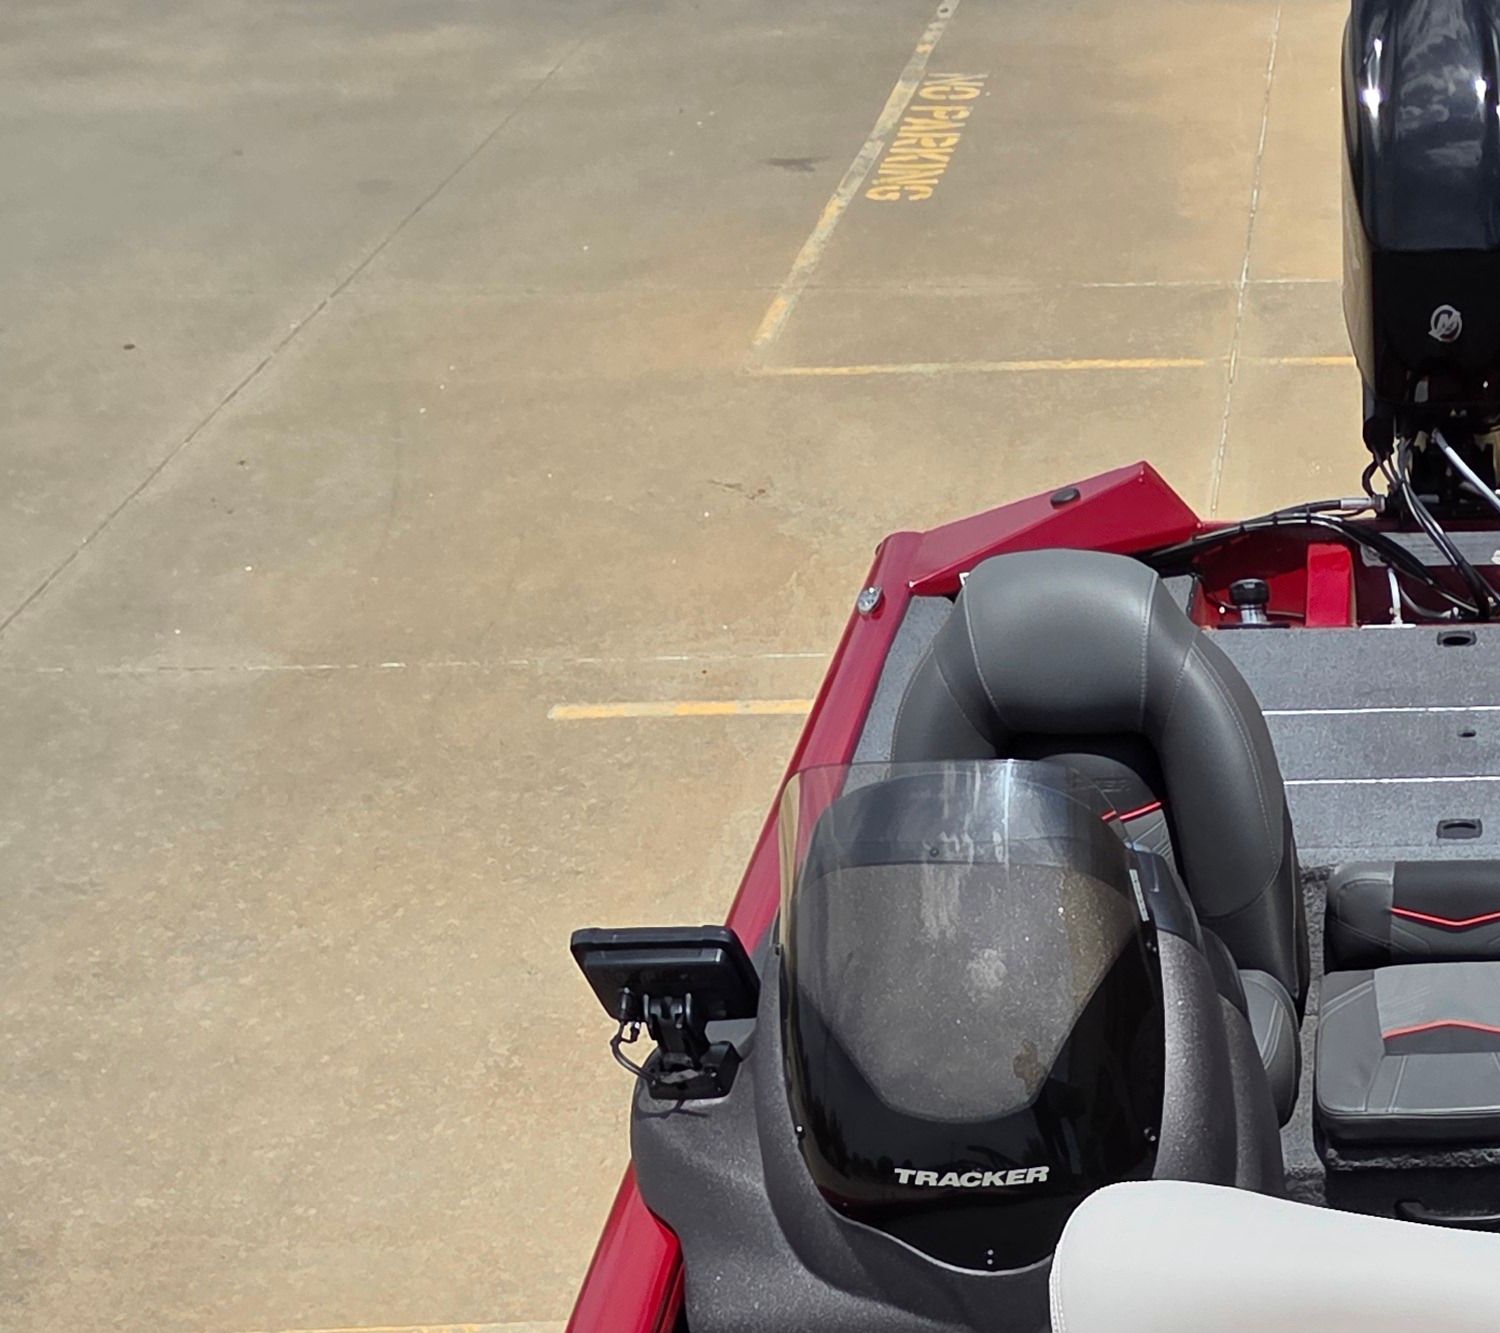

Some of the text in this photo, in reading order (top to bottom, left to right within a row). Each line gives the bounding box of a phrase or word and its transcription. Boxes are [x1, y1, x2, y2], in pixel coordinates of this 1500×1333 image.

[865, 73, 988, 200] NO PARKING
[893, 1165, 1051, 1188] TRACKER
